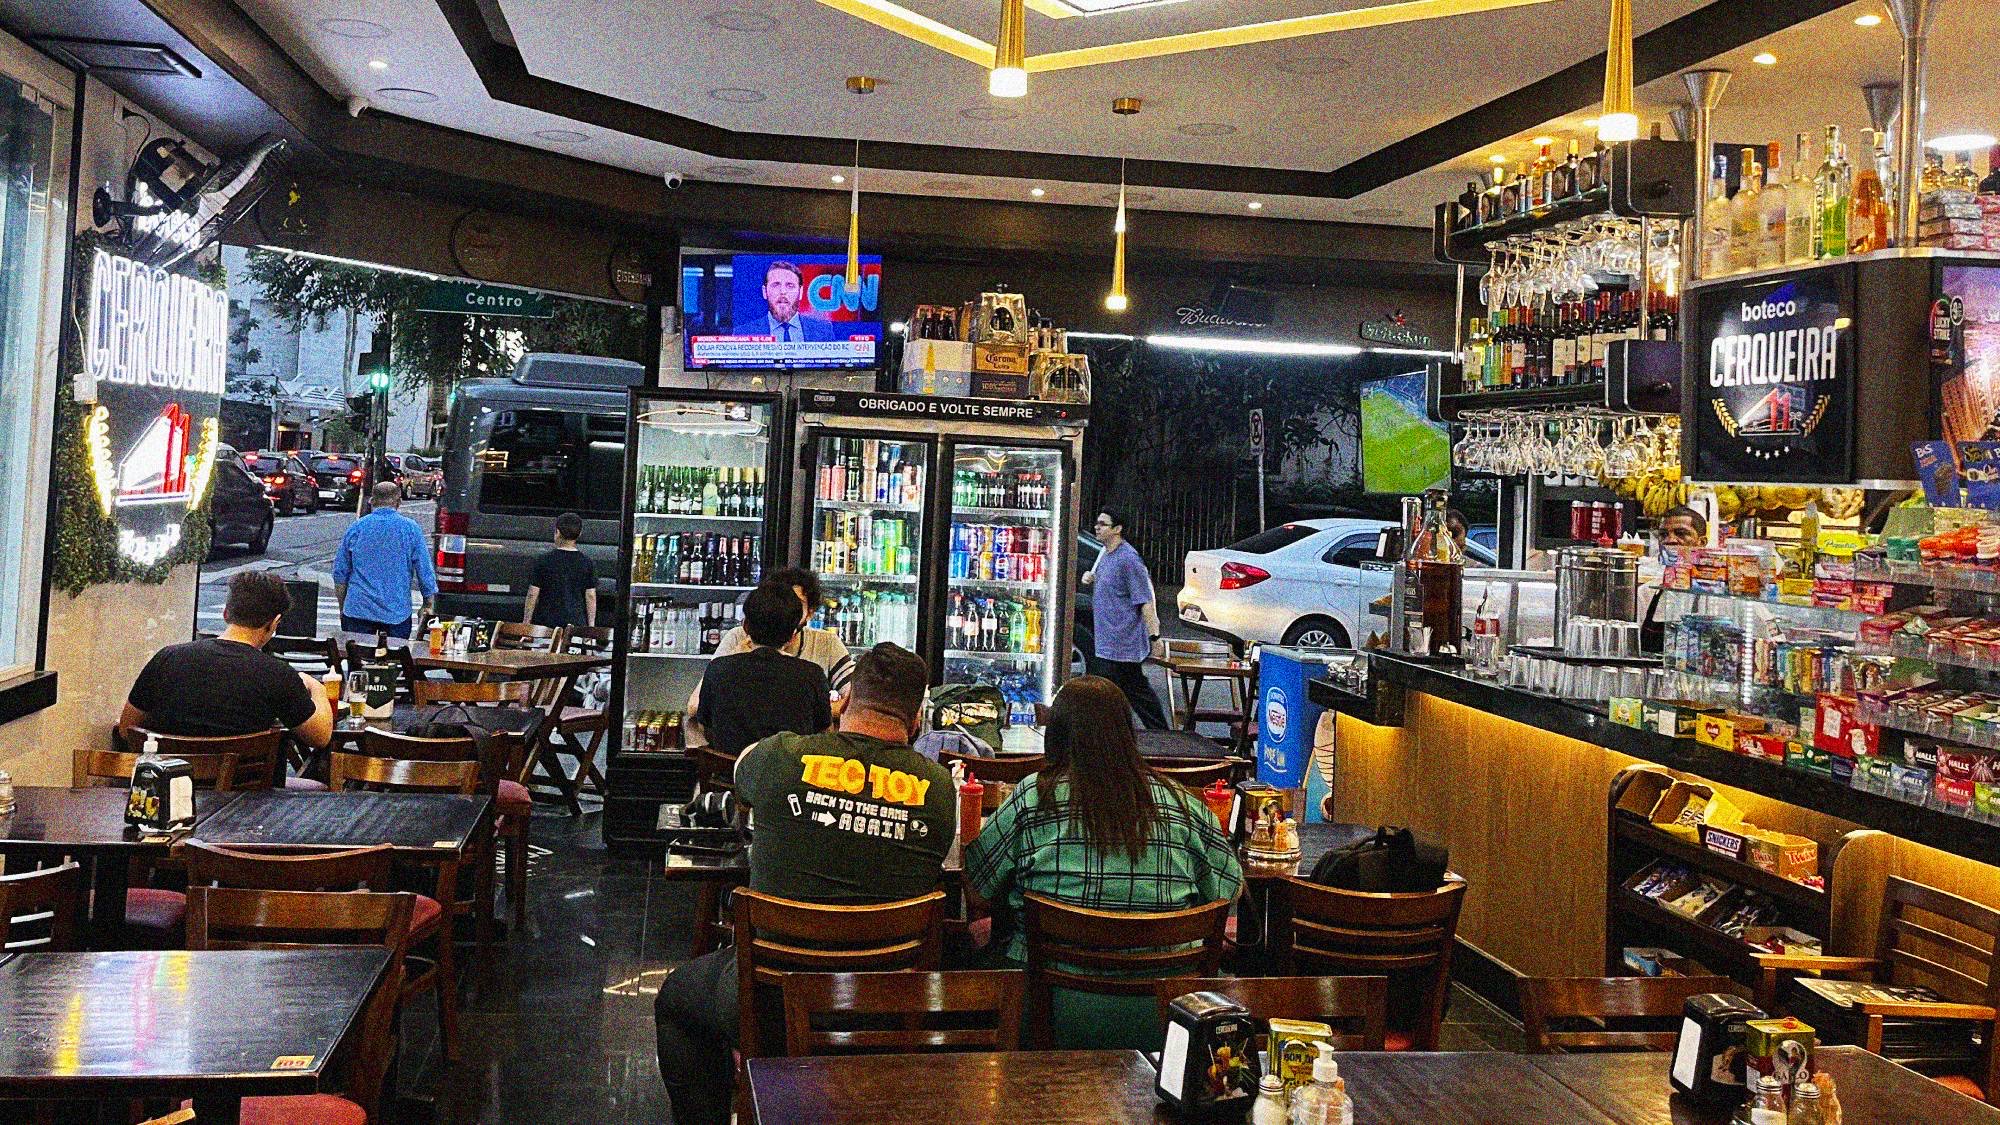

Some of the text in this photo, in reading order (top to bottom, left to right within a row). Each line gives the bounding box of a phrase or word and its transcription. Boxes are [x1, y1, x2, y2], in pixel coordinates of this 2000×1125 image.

[466, 292, 523, 307] Centro
[808, 274, 880, 311] CNN
[1741, 300, 1796, 322] boteco
[1709, 326, 1837, 387] CERQUEIRA
[858, 398, 1034, 418] OBRIGADO E VOLTE SEMPRE
[1915, 751, 1937, 762] HALLS
[1948, 760, 1970, 772] HALLS
[801, 754, 931, 806] TEC TOY
[806, 791, 909, 821] BACK TO THE GAME
[838, 812, 906, 840] AGAIN
[1707, 831, 1741, 850] SNICKERS
